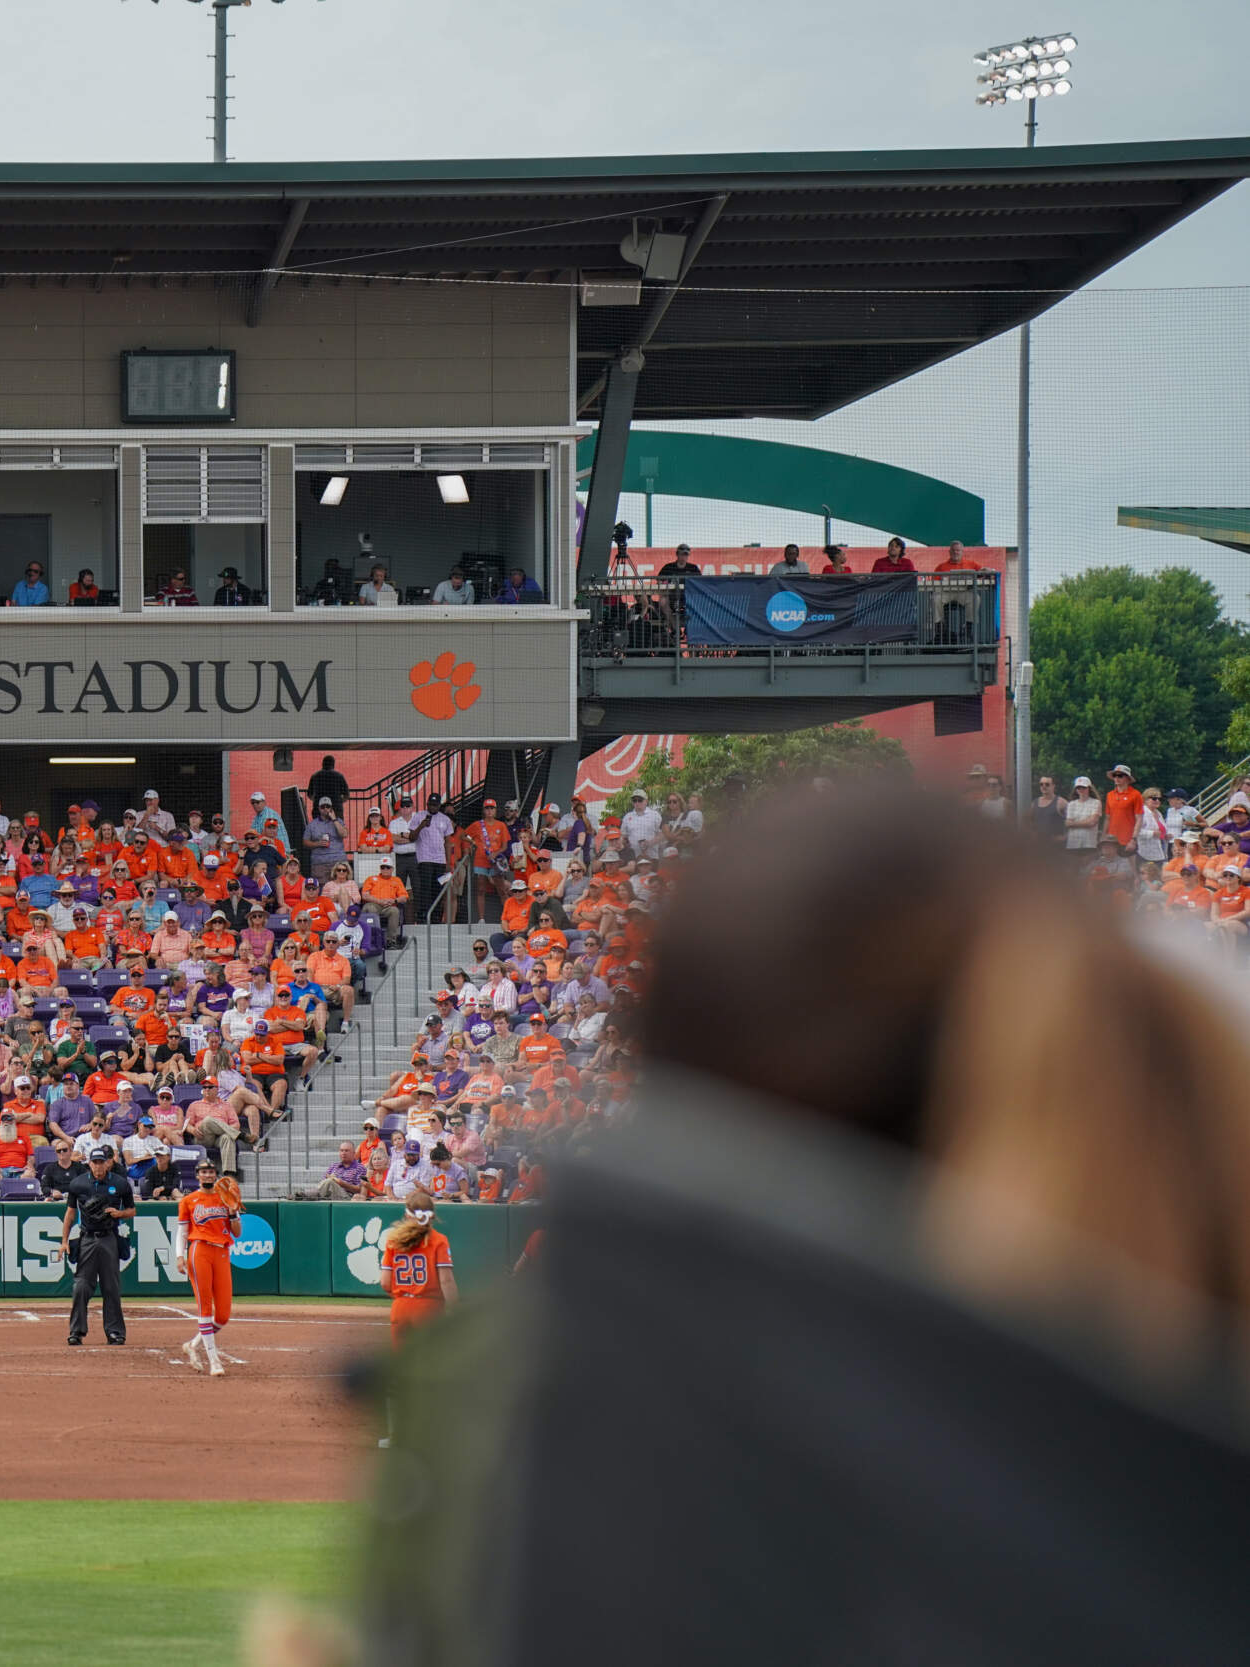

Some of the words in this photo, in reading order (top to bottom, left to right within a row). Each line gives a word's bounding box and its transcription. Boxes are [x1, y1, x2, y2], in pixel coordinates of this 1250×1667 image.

[217, 362, 228, 410] 1
[230, 1240, 274, 1256] NCAA
[394, 1254, 428, 1286] 28
